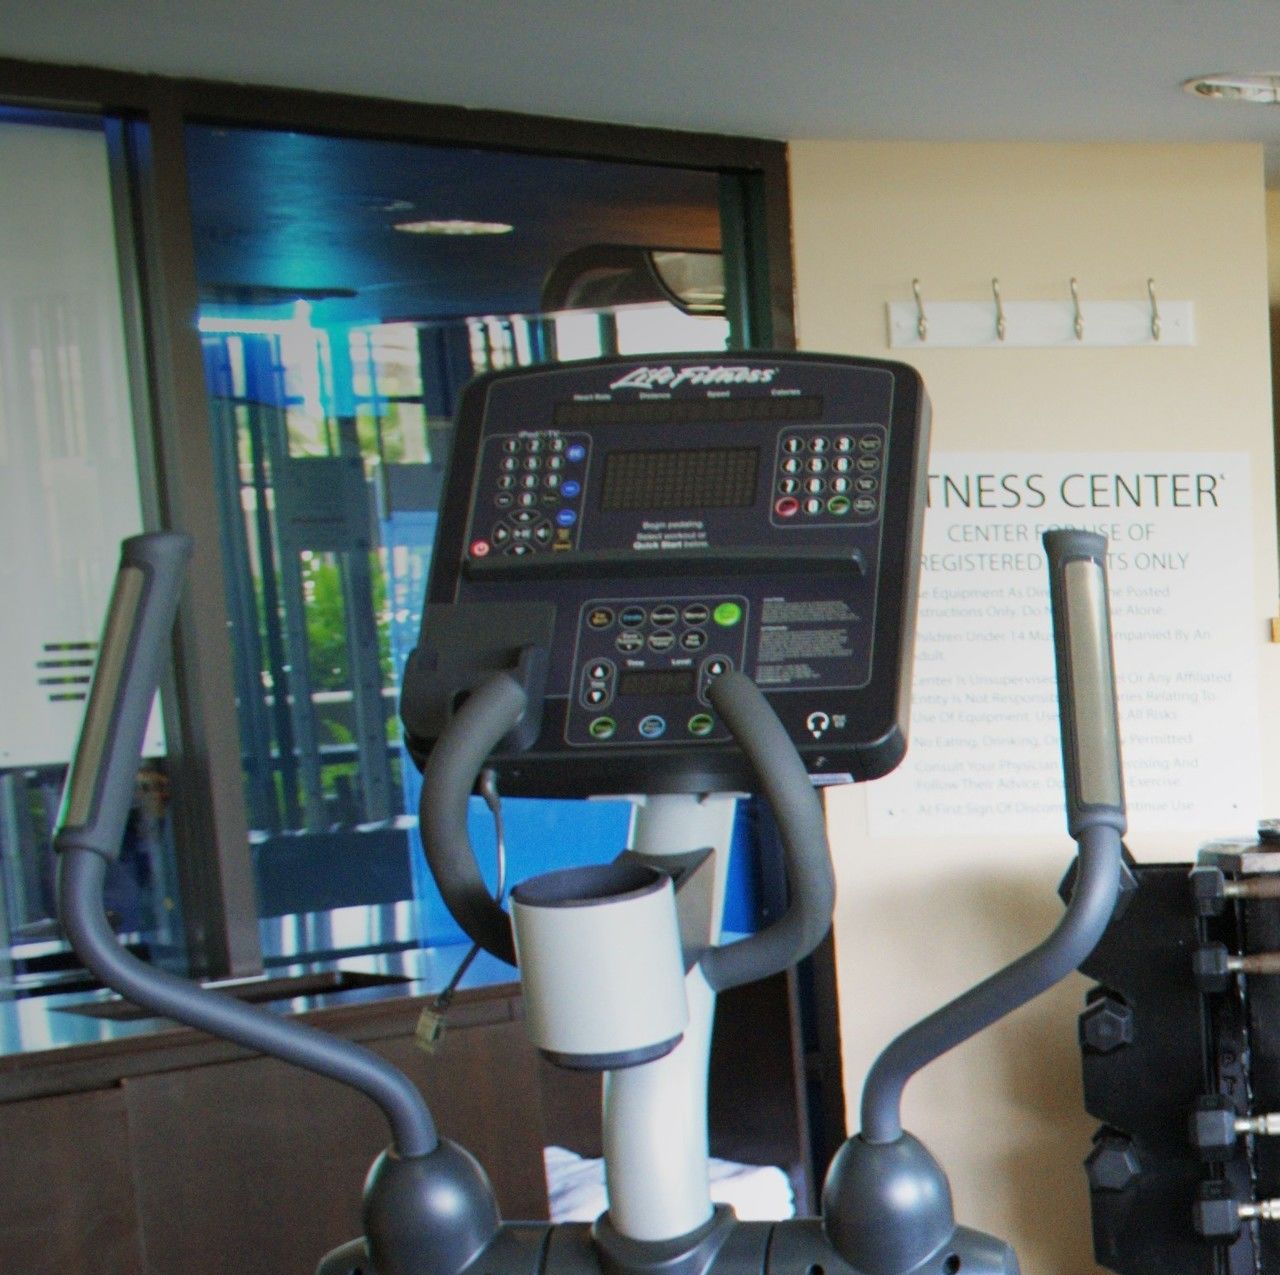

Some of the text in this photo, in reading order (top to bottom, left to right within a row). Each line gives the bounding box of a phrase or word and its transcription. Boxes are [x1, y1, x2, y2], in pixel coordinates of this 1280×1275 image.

[926, 474, 1219, 508] TNESS CENTER
[947, 524, 1029, 543] CENTER
[1127, 523, 1156, 541] OF
[633, 541, 659, 550] Quick
[661, 541, 682, 550] Start
[1134, 552, 1190, 570] ONLY
[932, 585, 1005, 603] Equipment
[1008, 586, 1024, 599] As
[1127, 584, 1171, 598] Posted
[966, 630, 1005, 643] Under
[1009, 630, 1026, 642] 14
[1175, 627, 1191, 643] By
[1193, 627, 1211, 640] An
[1128, 671, 1144, 683] Or
[1147, 671, 1172, 686] Any
[1175, 669, 1233, 683] Affiliated
[965, 691, 988, 704] Not
[1146, 688, 1199, 706] Relating
[1201, 688, 1216, 701] To
[913, 711, 937, 724] Use
[939, 711, 955, 723] Of
[1126, 708, 1143, 720] All
[1129, 733, 1194, 746] Permitted
[1173, 757, 1199, 769] And
[935, 802, 968, 816] First
[1171, 799, 1195, 811] Use
